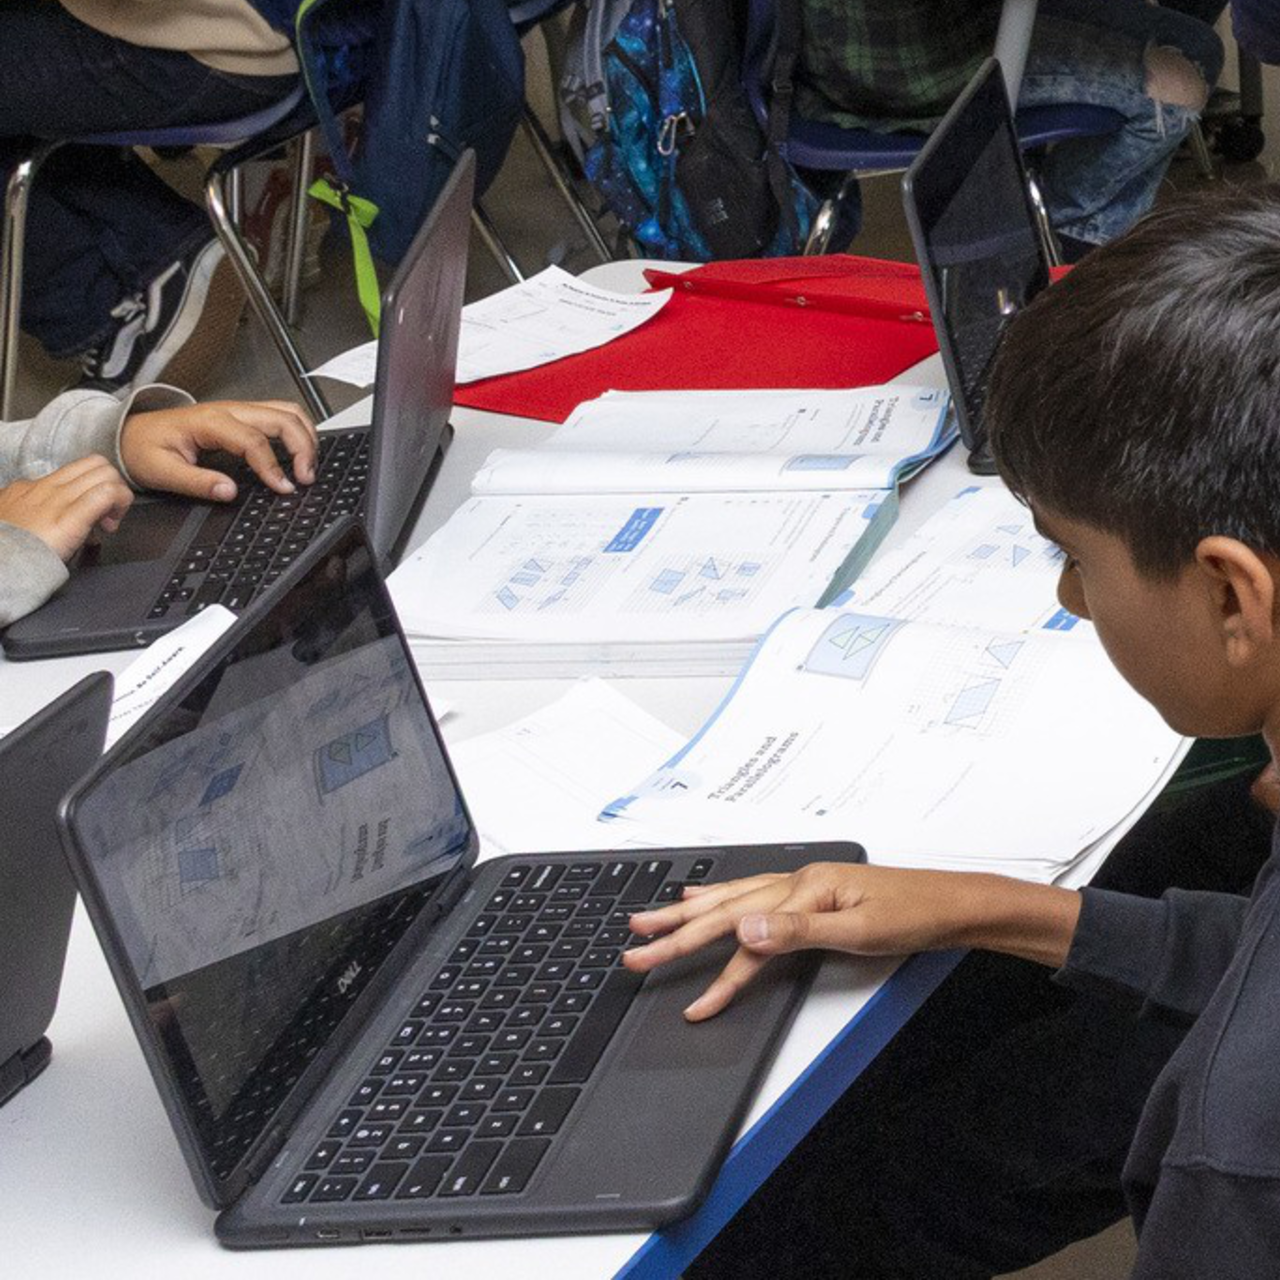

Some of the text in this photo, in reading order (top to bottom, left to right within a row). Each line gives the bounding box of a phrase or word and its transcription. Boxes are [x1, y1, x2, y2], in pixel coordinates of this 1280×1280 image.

[707, 758, 759, 800] Triangles
[755, 736, 777, 756] and
[725, 732, 799, 803] Parallelograms
[337, 961, 361, 994] DELL
